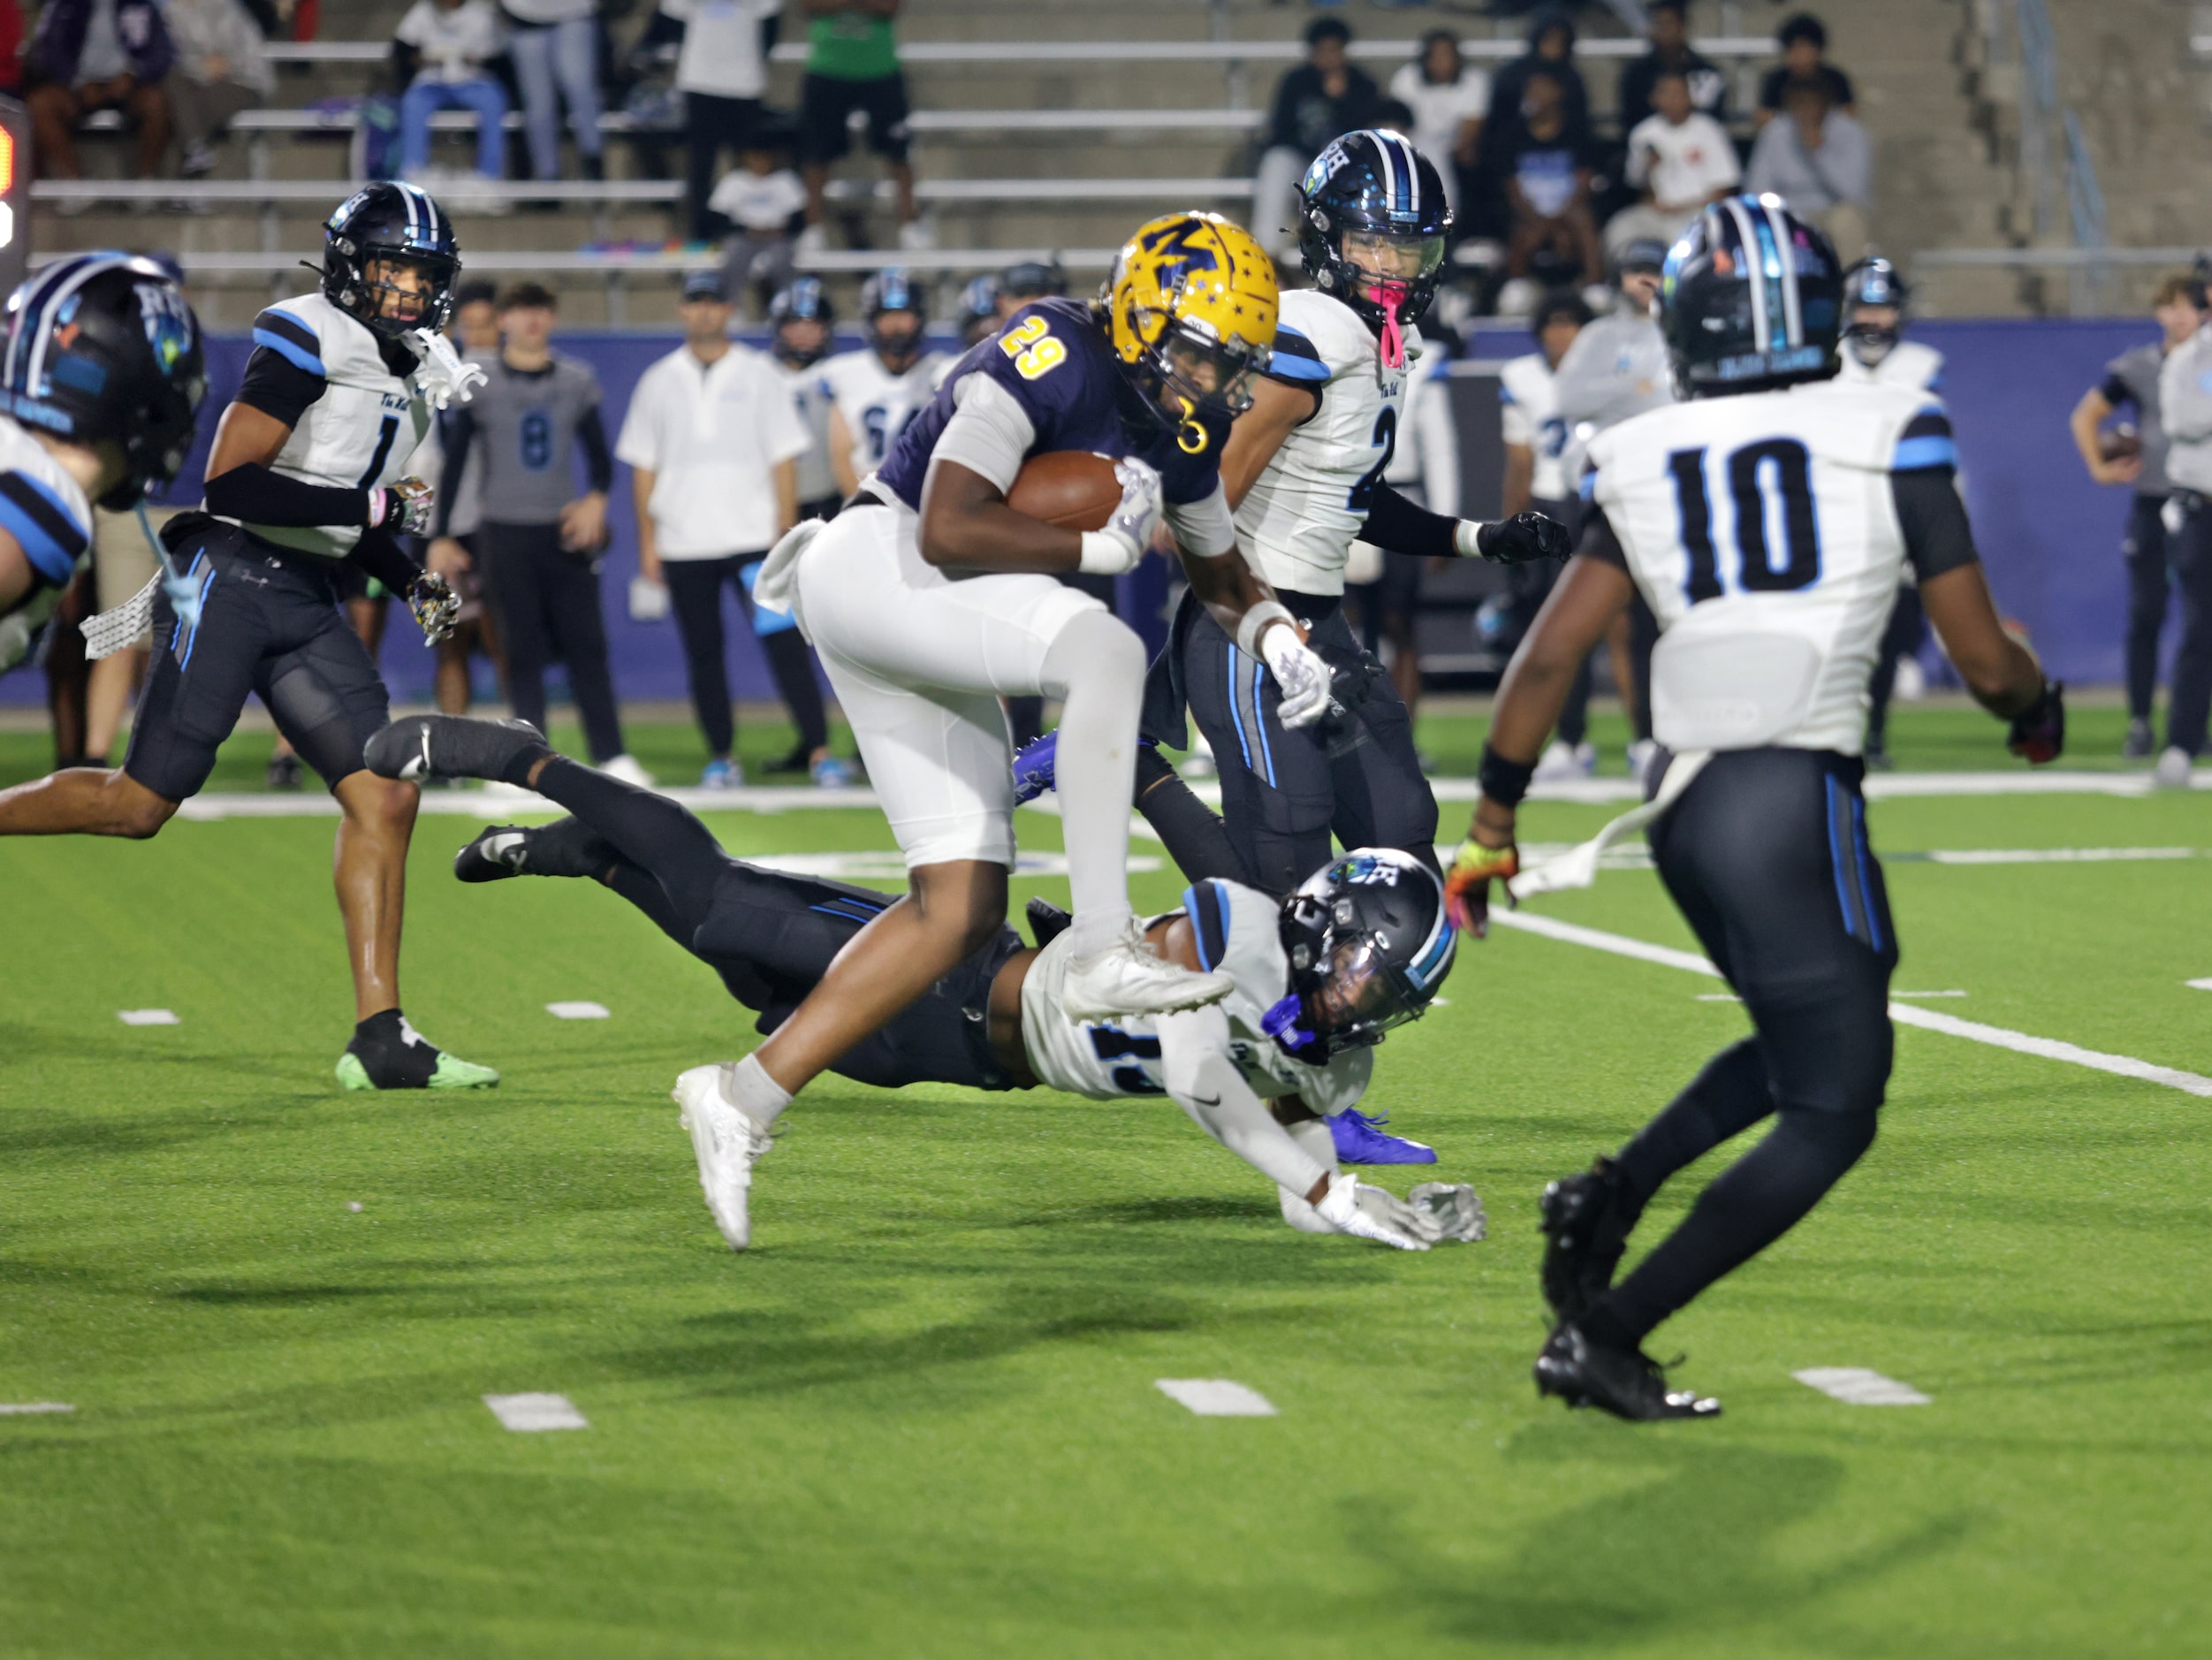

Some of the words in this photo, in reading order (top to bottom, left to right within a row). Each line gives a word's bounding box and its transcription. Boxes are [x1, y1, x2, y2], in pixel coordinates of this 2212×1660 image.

[1141, 218, 1218, 291] M
[998, 315, 1068, 381] 29
[357, 413, 400, 490] 1
[1344, 404, 1396, 513] 2
[1662, 437, 1823, 608] 10
